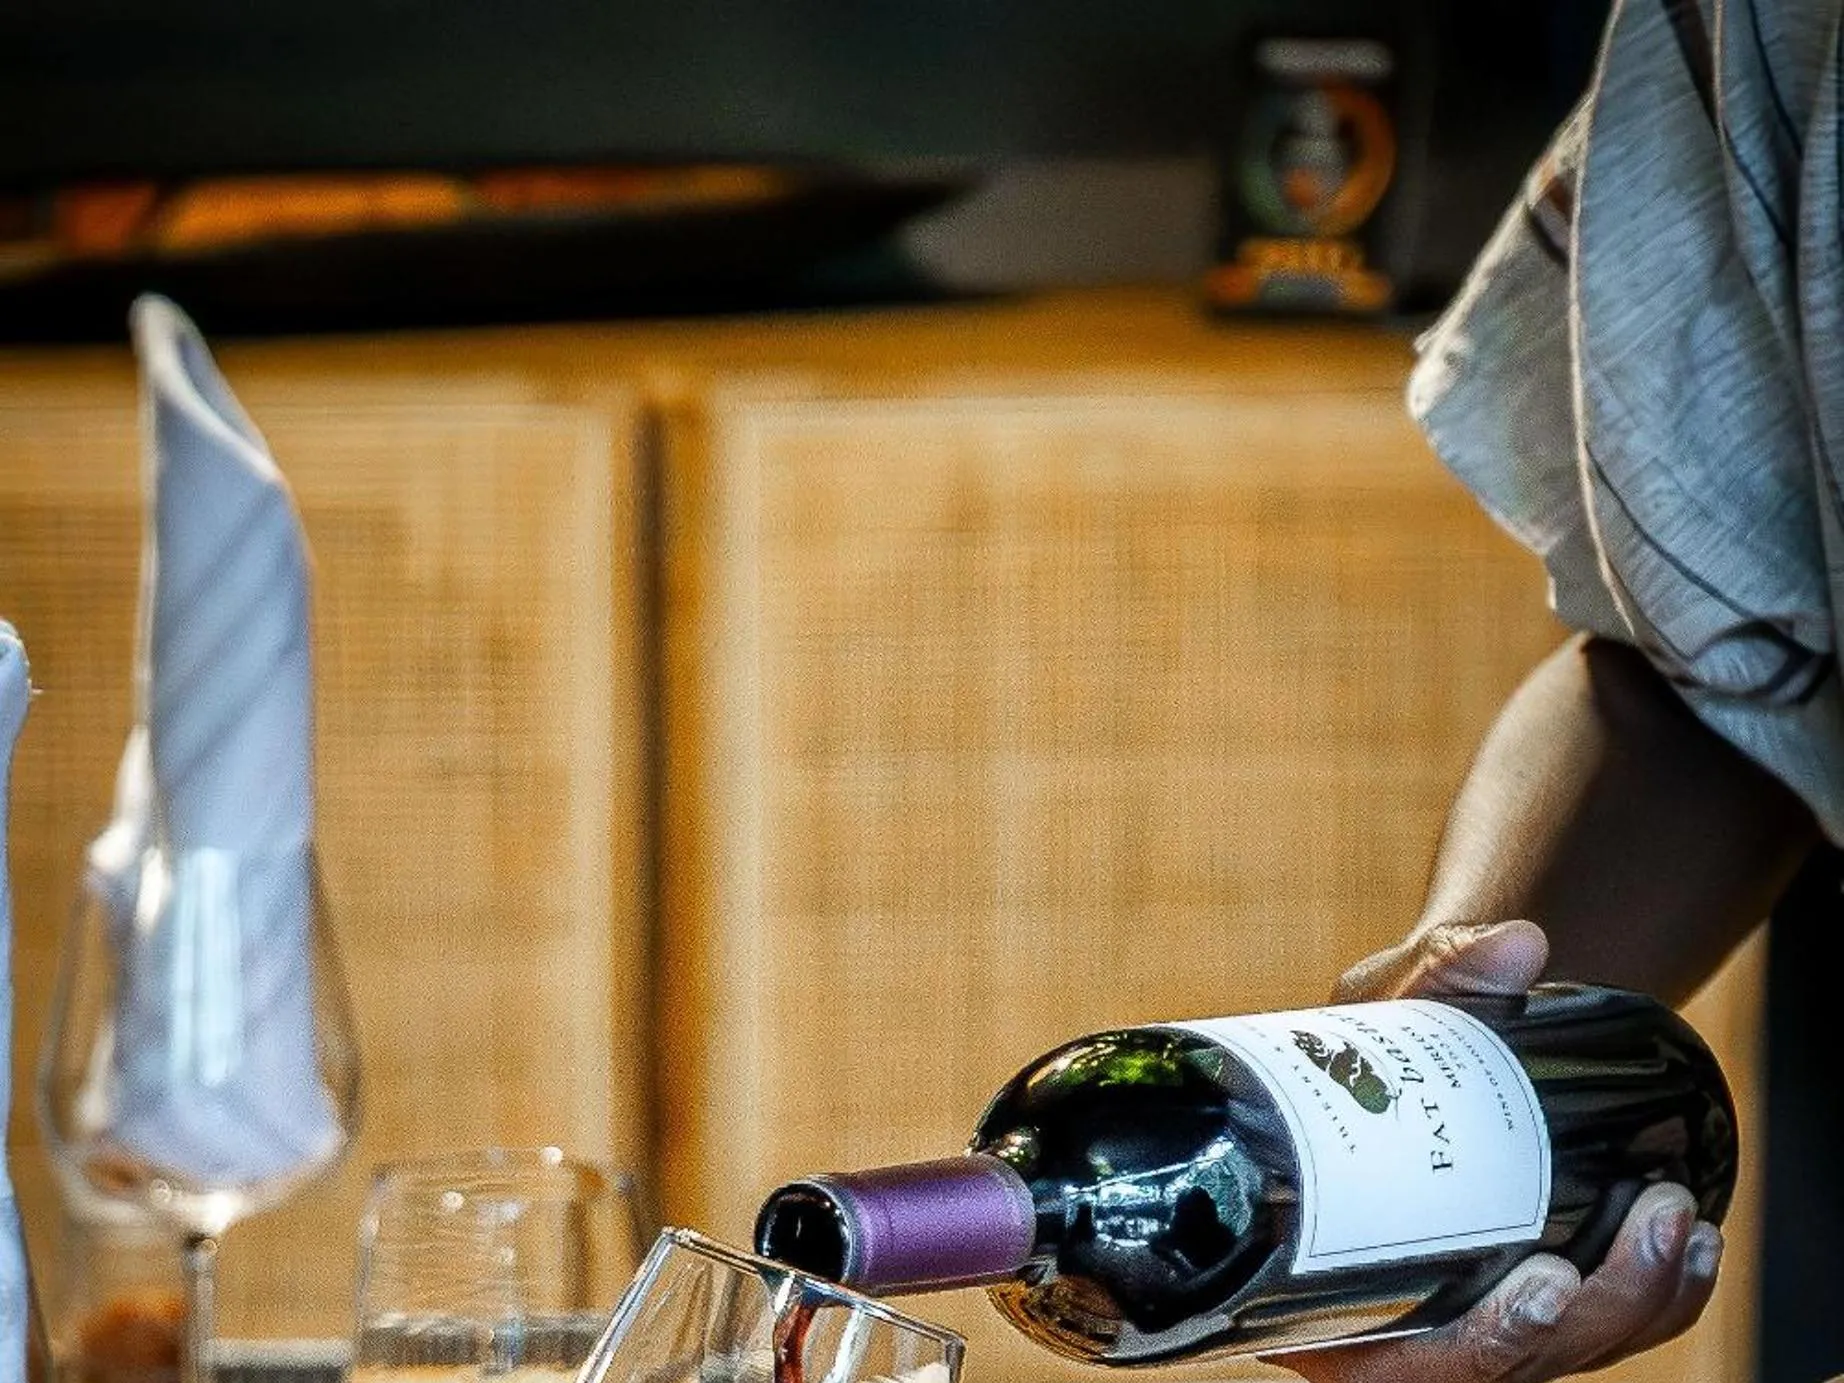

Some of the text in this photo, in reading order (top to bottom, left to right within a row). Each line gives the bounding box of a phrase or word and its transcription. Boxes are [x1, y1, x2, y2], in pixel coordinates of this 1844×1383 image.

[1319, 1011, 1425, 1084] bast
[1400, 1026, 1461, 1088] MERLOT
[1421, 1097, 1454, 1174] FAT
